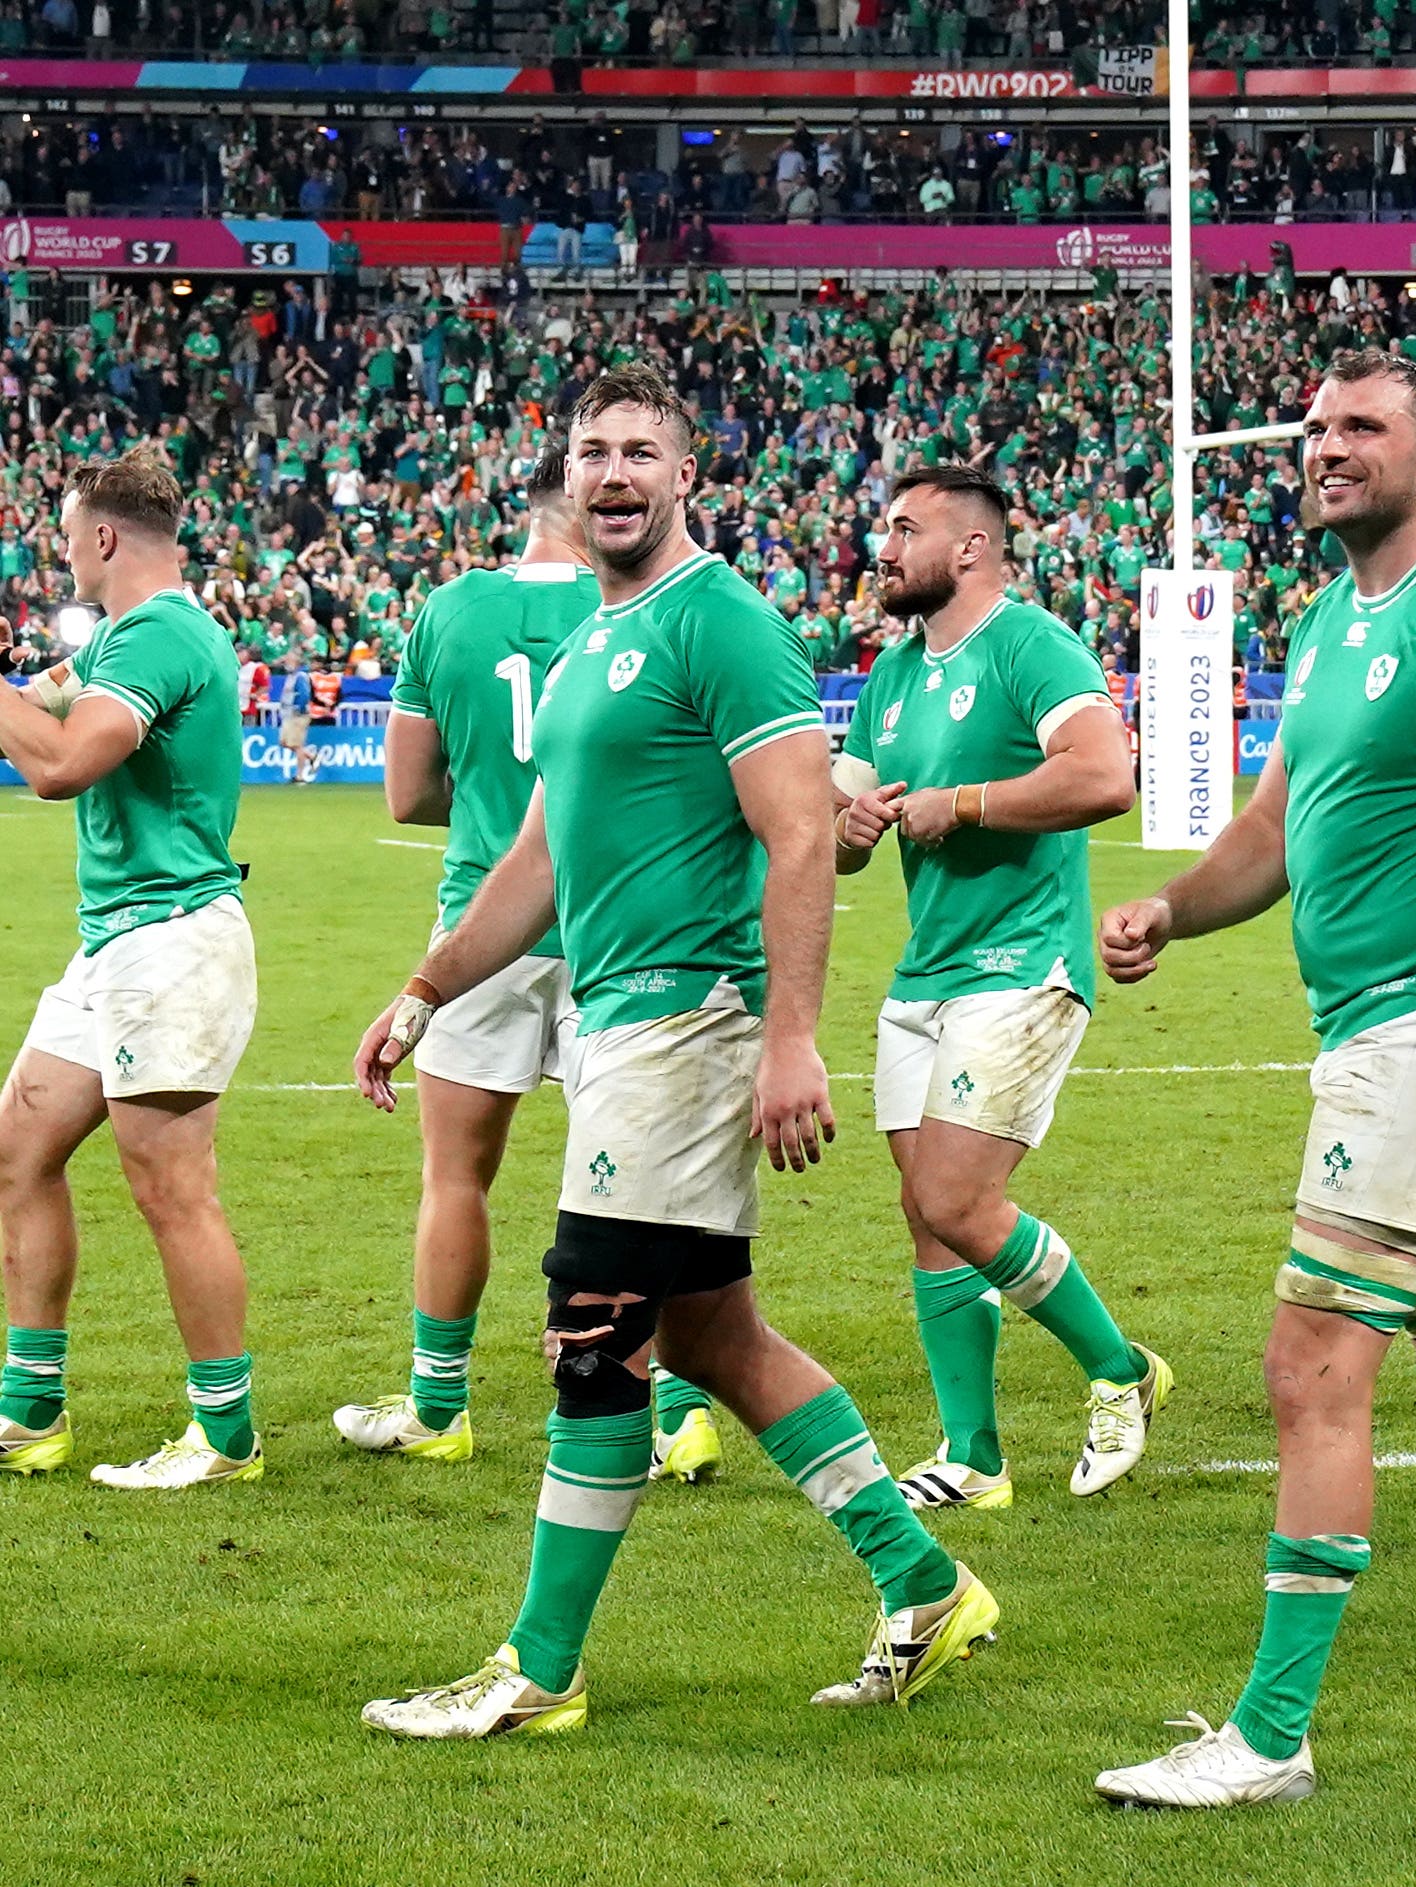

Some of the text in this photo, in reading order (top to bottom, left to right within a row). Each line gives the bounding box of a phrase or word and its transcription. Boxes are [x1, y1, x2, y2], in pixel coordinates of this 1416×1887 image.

[1099, 74, 1153, 95] TOUR
[34, 236, 122, 249] WORLD CUP
[1189, 654, 1212, 721] 2023
[1321, 1177, 1344, 1190] IRFU
